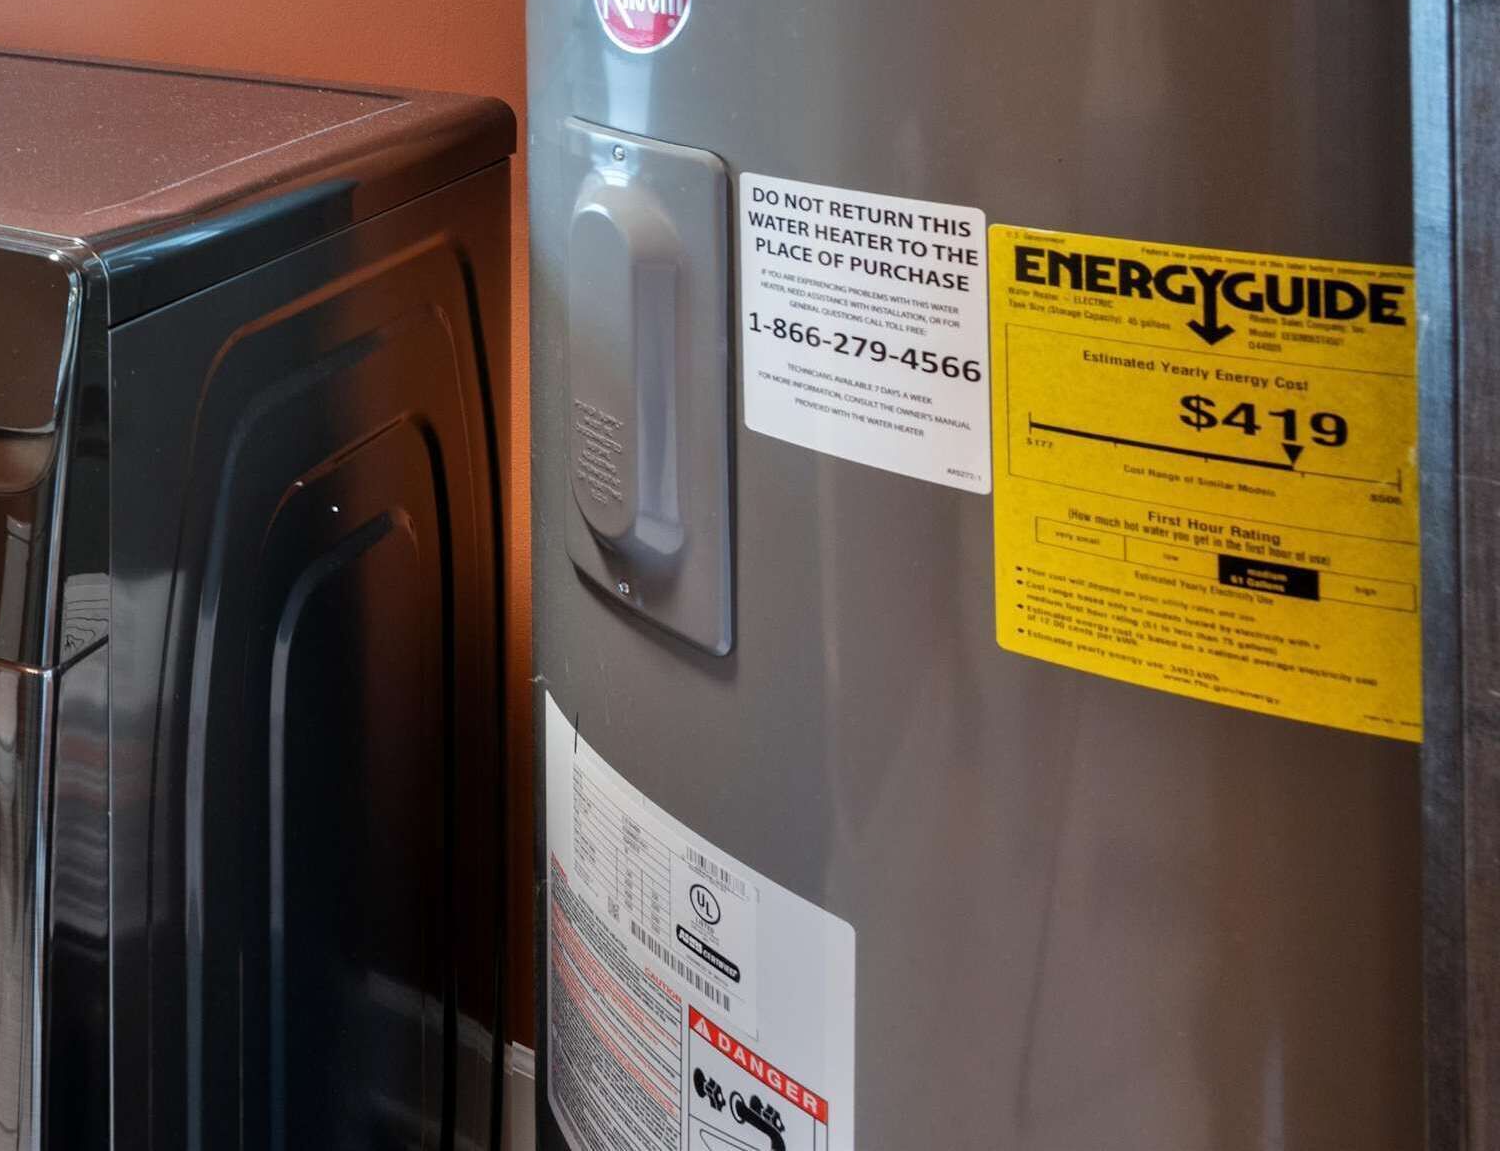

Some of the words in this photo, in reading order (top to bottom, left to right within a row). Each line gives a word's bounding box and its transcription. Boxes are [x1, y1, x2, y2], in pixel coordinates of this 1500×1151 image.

[753, 187, 779, 206] DO
[784, 193, 824, 214] NOT
[829, 201, 913, 230] RETURN
[918, 215, 972, 238] THIS
[748, 210, 810, 238] WATER
[815, 224, 893, 252] HEATER
[897, 238, 928, 258] TO
[932, 244, 979, 266] THE
[756, 237, 813, 263] PLACE
[818, 250, 844, 268] OF
[850, 256, 970, 292] PURCHASE
[768, 270, 782, 279] YOU
[783, 273, 796, 282] ARE
[797, 276, 847, 294] EXPERIENCING
[848, 286, 889, 302] PROBLEMS
[890, 295, 910, 306] WITH
[912, 299, 930, 310] THIS
[930, 303, 960, 314] WATER
[788, 287, 806, 297] NEED
[807, 291, 848, 307] ASSISTANCE
[850, 301, 870, 310] WITH
[871, 304, 928, 325] INSTALLATION,
[929, 316, 942, 326] OR
[943, 318, 961, 328] FOR
[1015, 245, 1407, 328] ENERGYGUIDE
[789, 300, 820, 314] GENERAL
[822, 308, 863, 324] QUESTIONS
[864, 317, 885, 328] CALL
[886, 321, 904, 332] TOLL
[749, 312, 982, 383] 1-866-279-4566
[834, 376, 872, 391] AVAILABLE
[880, 386, 900, 398] DAYS
[903, 392, 909, 400] A
[1083, 350, 1155, 372] Estimated
[1160, 361, 1210, 380] Yearly
[1215, 368, 1269, 390] Energy
[1274, 376, 1308, 392] Cost
[772, 375, 792, 387] MORE
[844, 393, 879, 408] CONSULT
[880, 402, 894, 413] THE
[934, 416, 972, 430] MANUAL
[794, 397, 830, 414] PROVIDED
[831, 408, 850, 418] WITH
[852, 412, 865, 422] THE
[866, 415, 893, 429] WATER
[894, 422, 924, 437] HEATER
[1180, 394, 1348, 448] $419
[1123, 464, 1146, 475] Cost
[1148, 468, 1181, 483] Range
[1184, 474, 1194, 483] of
[1198, 476, 1234, 491] Similar
[1238, 483, 1276, 498] Models
[1124, 519, 1140, 532] hot
[1142, 526, 1170, 538] water
[1225, 538, 1242, 551] the
[1148, 510, 1181, 527] First
[1188, 518, 1224, 534] Hour
[1230, 525, 1282, 546] Rating
[643, 966, 682, 1005] CAUTION
[717, 1031, 818, 1115] DANGER
